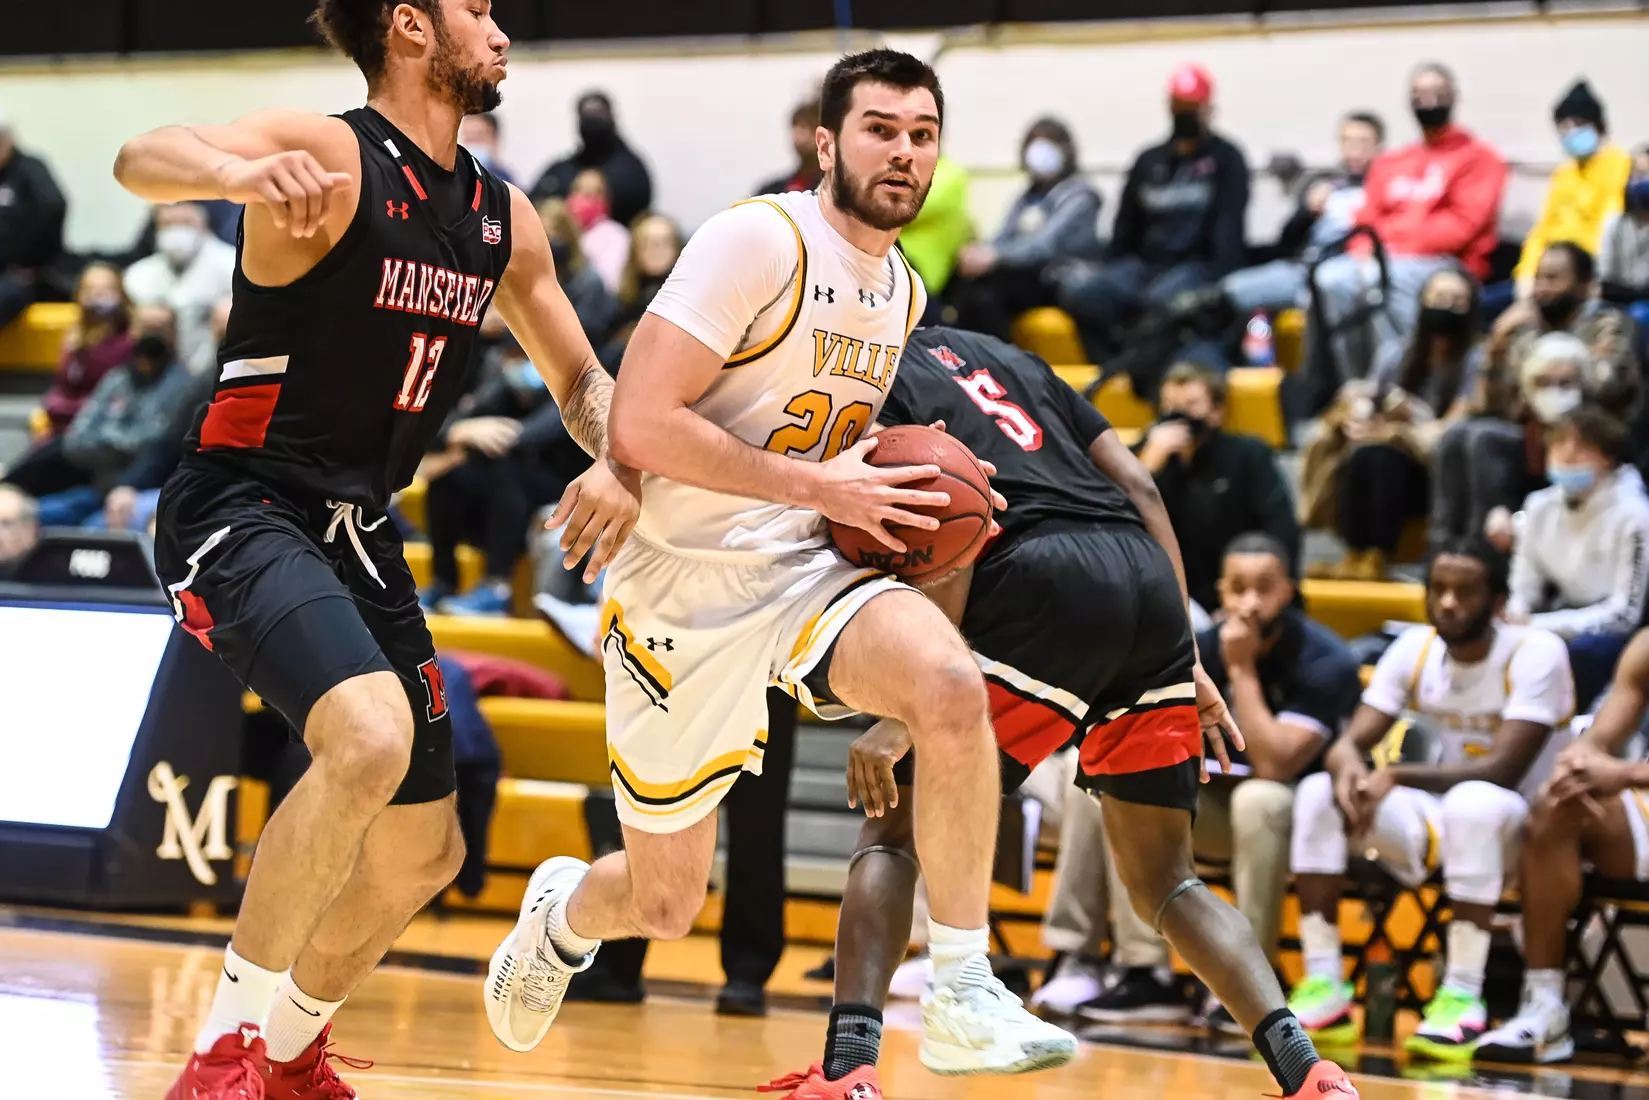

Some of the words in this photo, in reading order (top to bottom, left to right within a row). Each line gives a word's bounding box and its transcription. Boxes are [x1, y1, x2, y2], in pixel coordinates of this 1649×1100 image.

[393, 332, 448, 412] 12
[952, 367, 1043, 452] 5
[763, 389, 873, 462] 20
[492, 954, 513, 1002] ADVISORY
